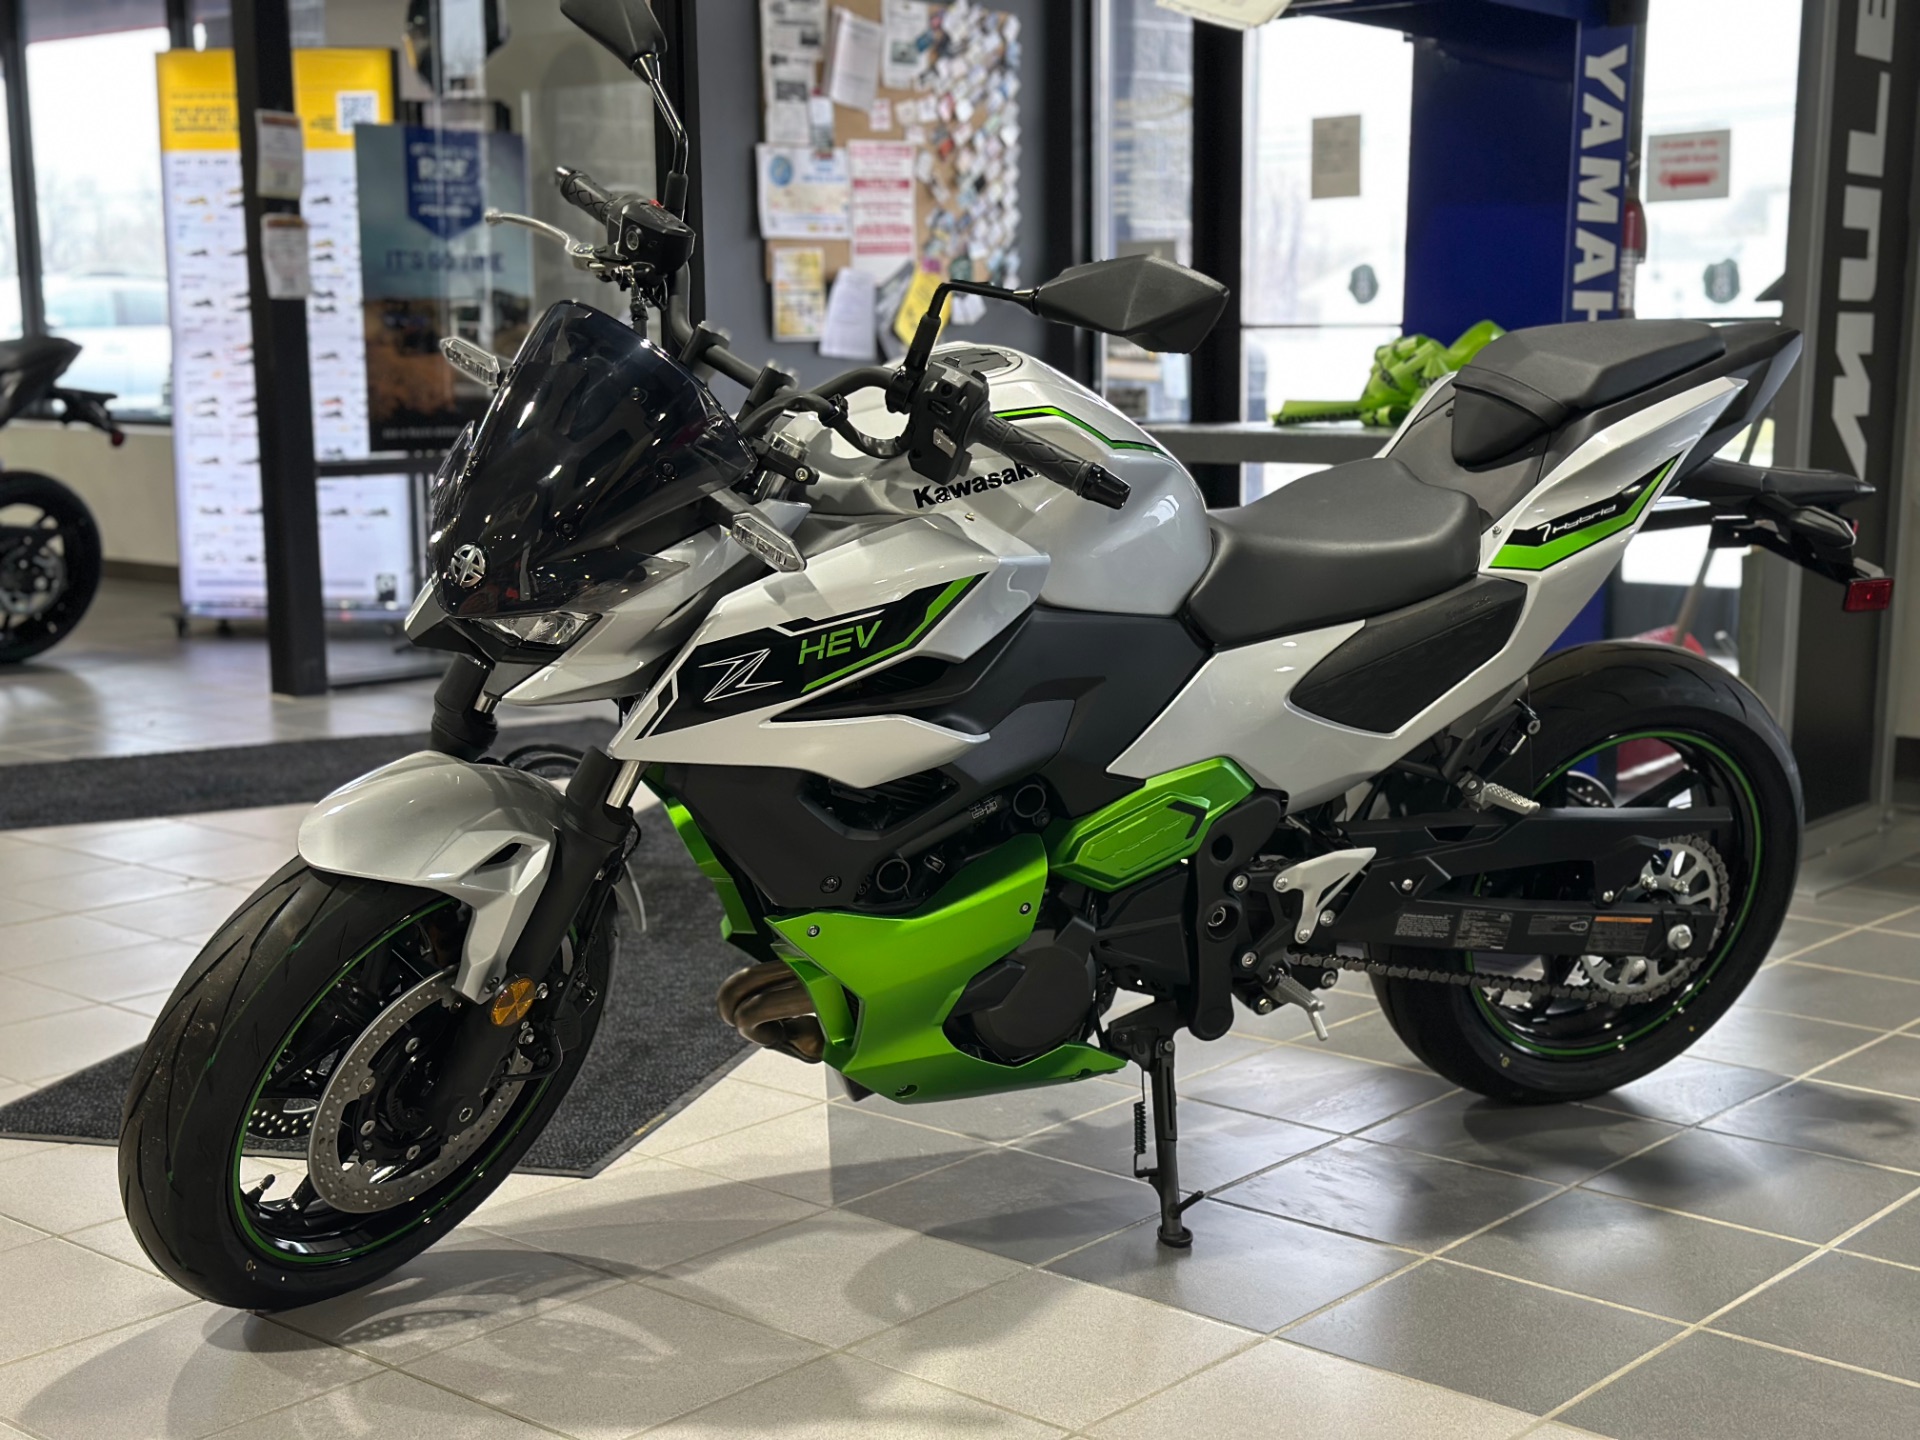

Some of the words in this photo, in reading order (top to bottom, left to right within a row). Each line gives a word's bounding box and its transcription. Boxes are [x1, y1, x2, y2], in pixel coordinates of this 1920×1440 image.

[913, 464, 1041, 509] Kawasak
[698, 647, 783, 703] Z
[797, 620, 883, 666] HEV
